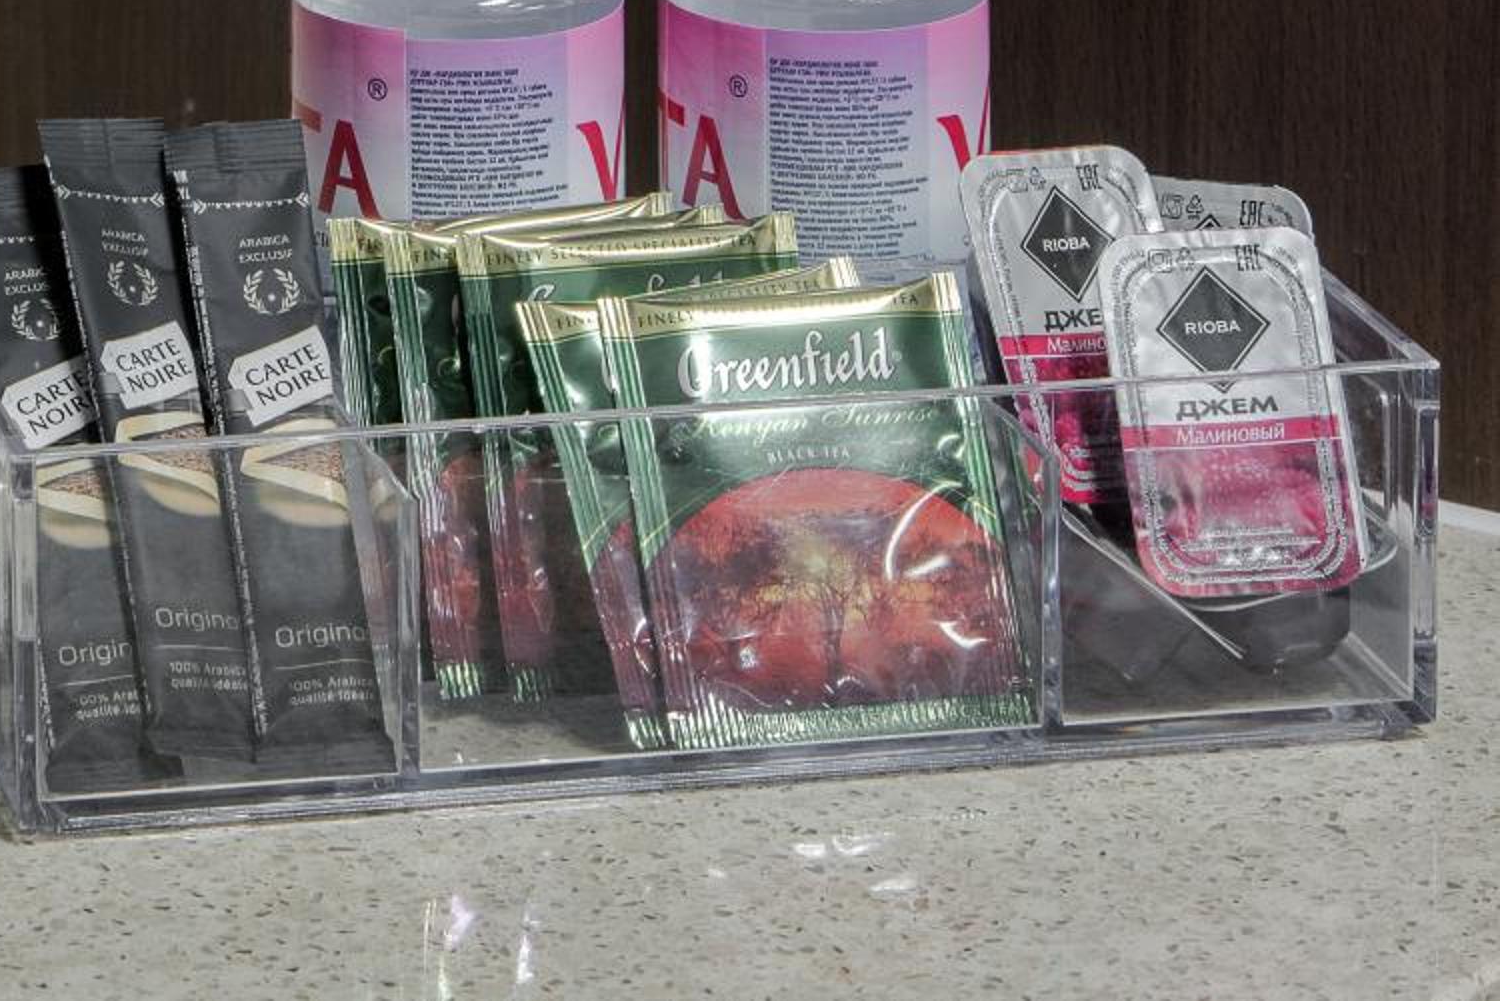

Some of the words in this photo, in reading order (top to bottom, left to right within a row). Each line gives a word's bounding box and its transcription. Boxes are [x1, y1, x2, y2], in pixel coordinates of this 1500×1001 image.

[1042, 237, 1090, 252] RIOBA
[1044, 308, 1103, 333] ДЖЕ
[1184, 320, 1241, 335] RIOBA
[116, 337, 180, 373] CARTE
[1047, 337, 1107, 354] Малино
[245, 343, 320, 386] CARTE
[677, 327, 895, 398] Greenfield
[127, 358, 193, 393] NOIRE
[256, 362, 330, 406] NOIRE
[1176, 396, 1279, 422] ДЖЕМ
[1176, 422, 1285, 445] Малиновый
[156, 607, 239, 632] Origina
[275, 623, 366, 648] Origina
[59, 638, 133, 666] Origin
